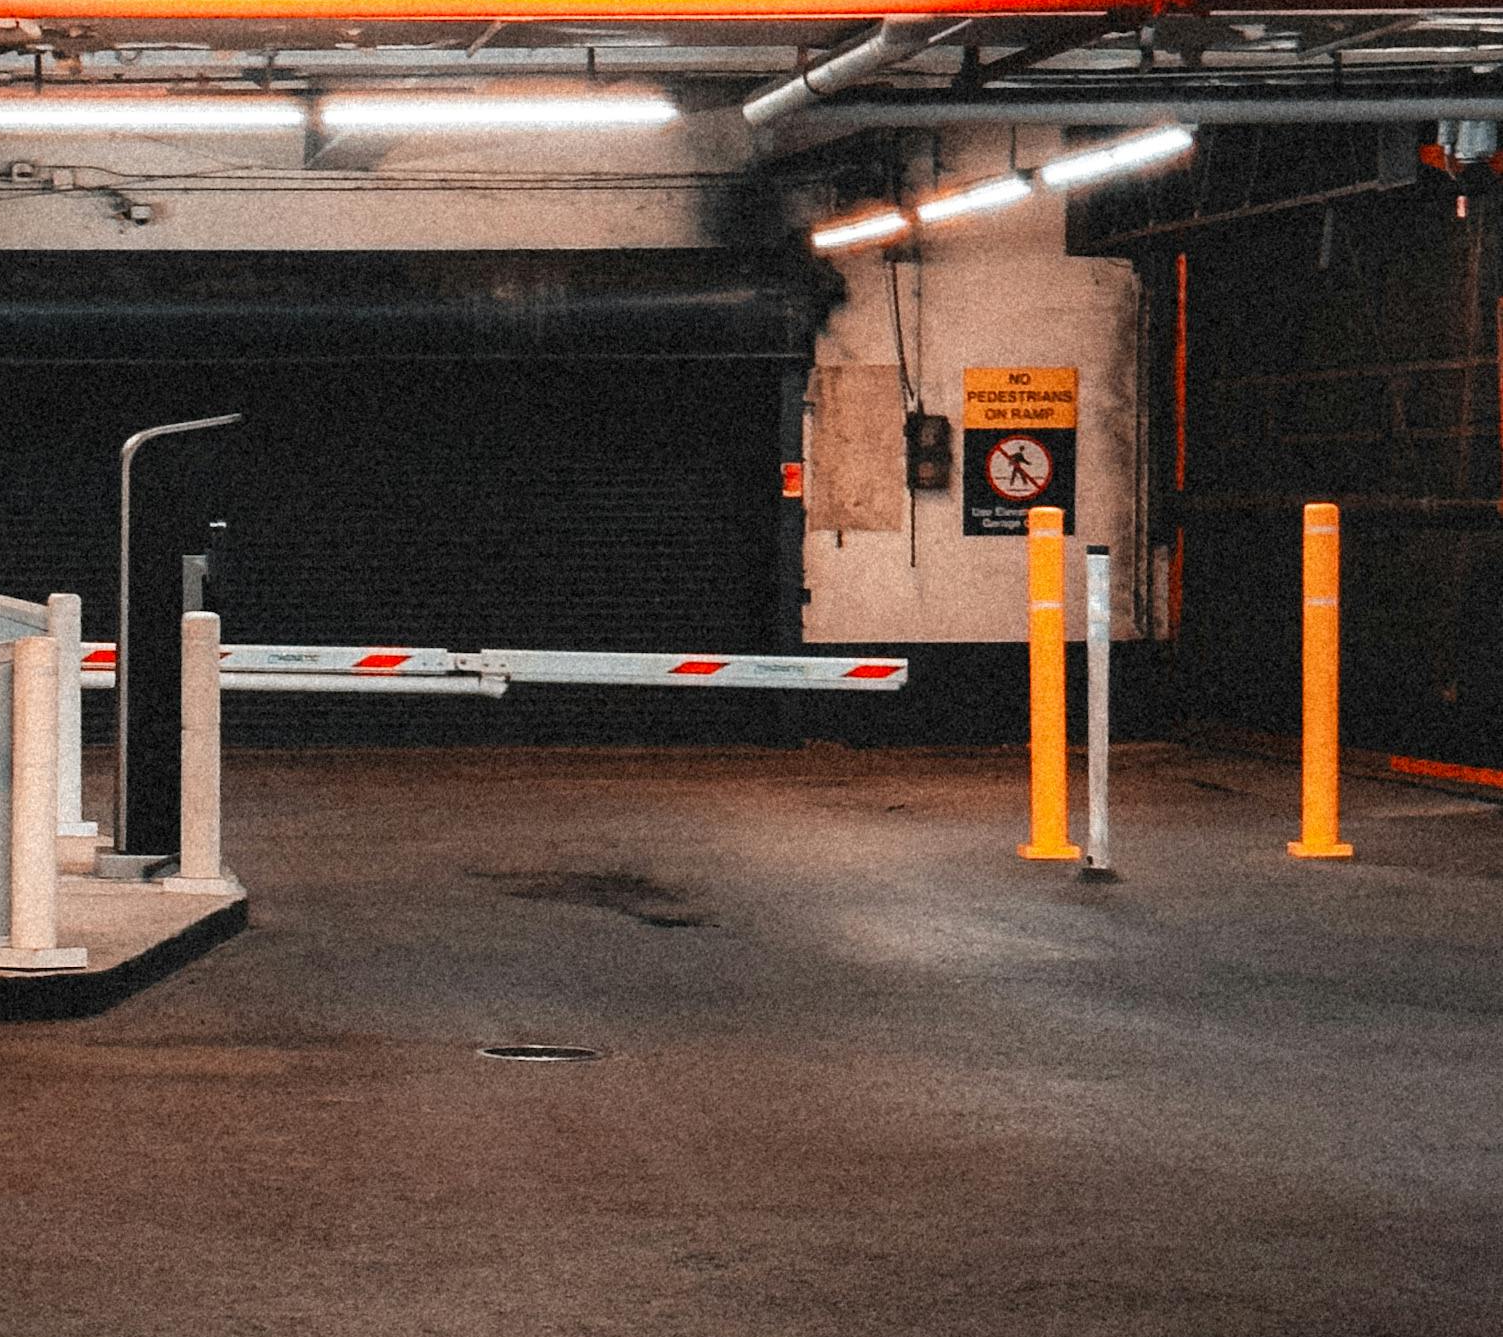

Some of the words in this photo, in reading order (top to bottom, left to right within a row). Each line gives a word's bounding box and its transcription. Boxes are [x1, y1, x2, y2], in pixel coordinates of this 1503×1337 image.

[1008, 372, 1031, 386] NO
[967, 390, 1073, 404] PEDESTRIANS
[984, 407, 1008, 421] ON
[1010, 407, 1055, 421] RAMP
